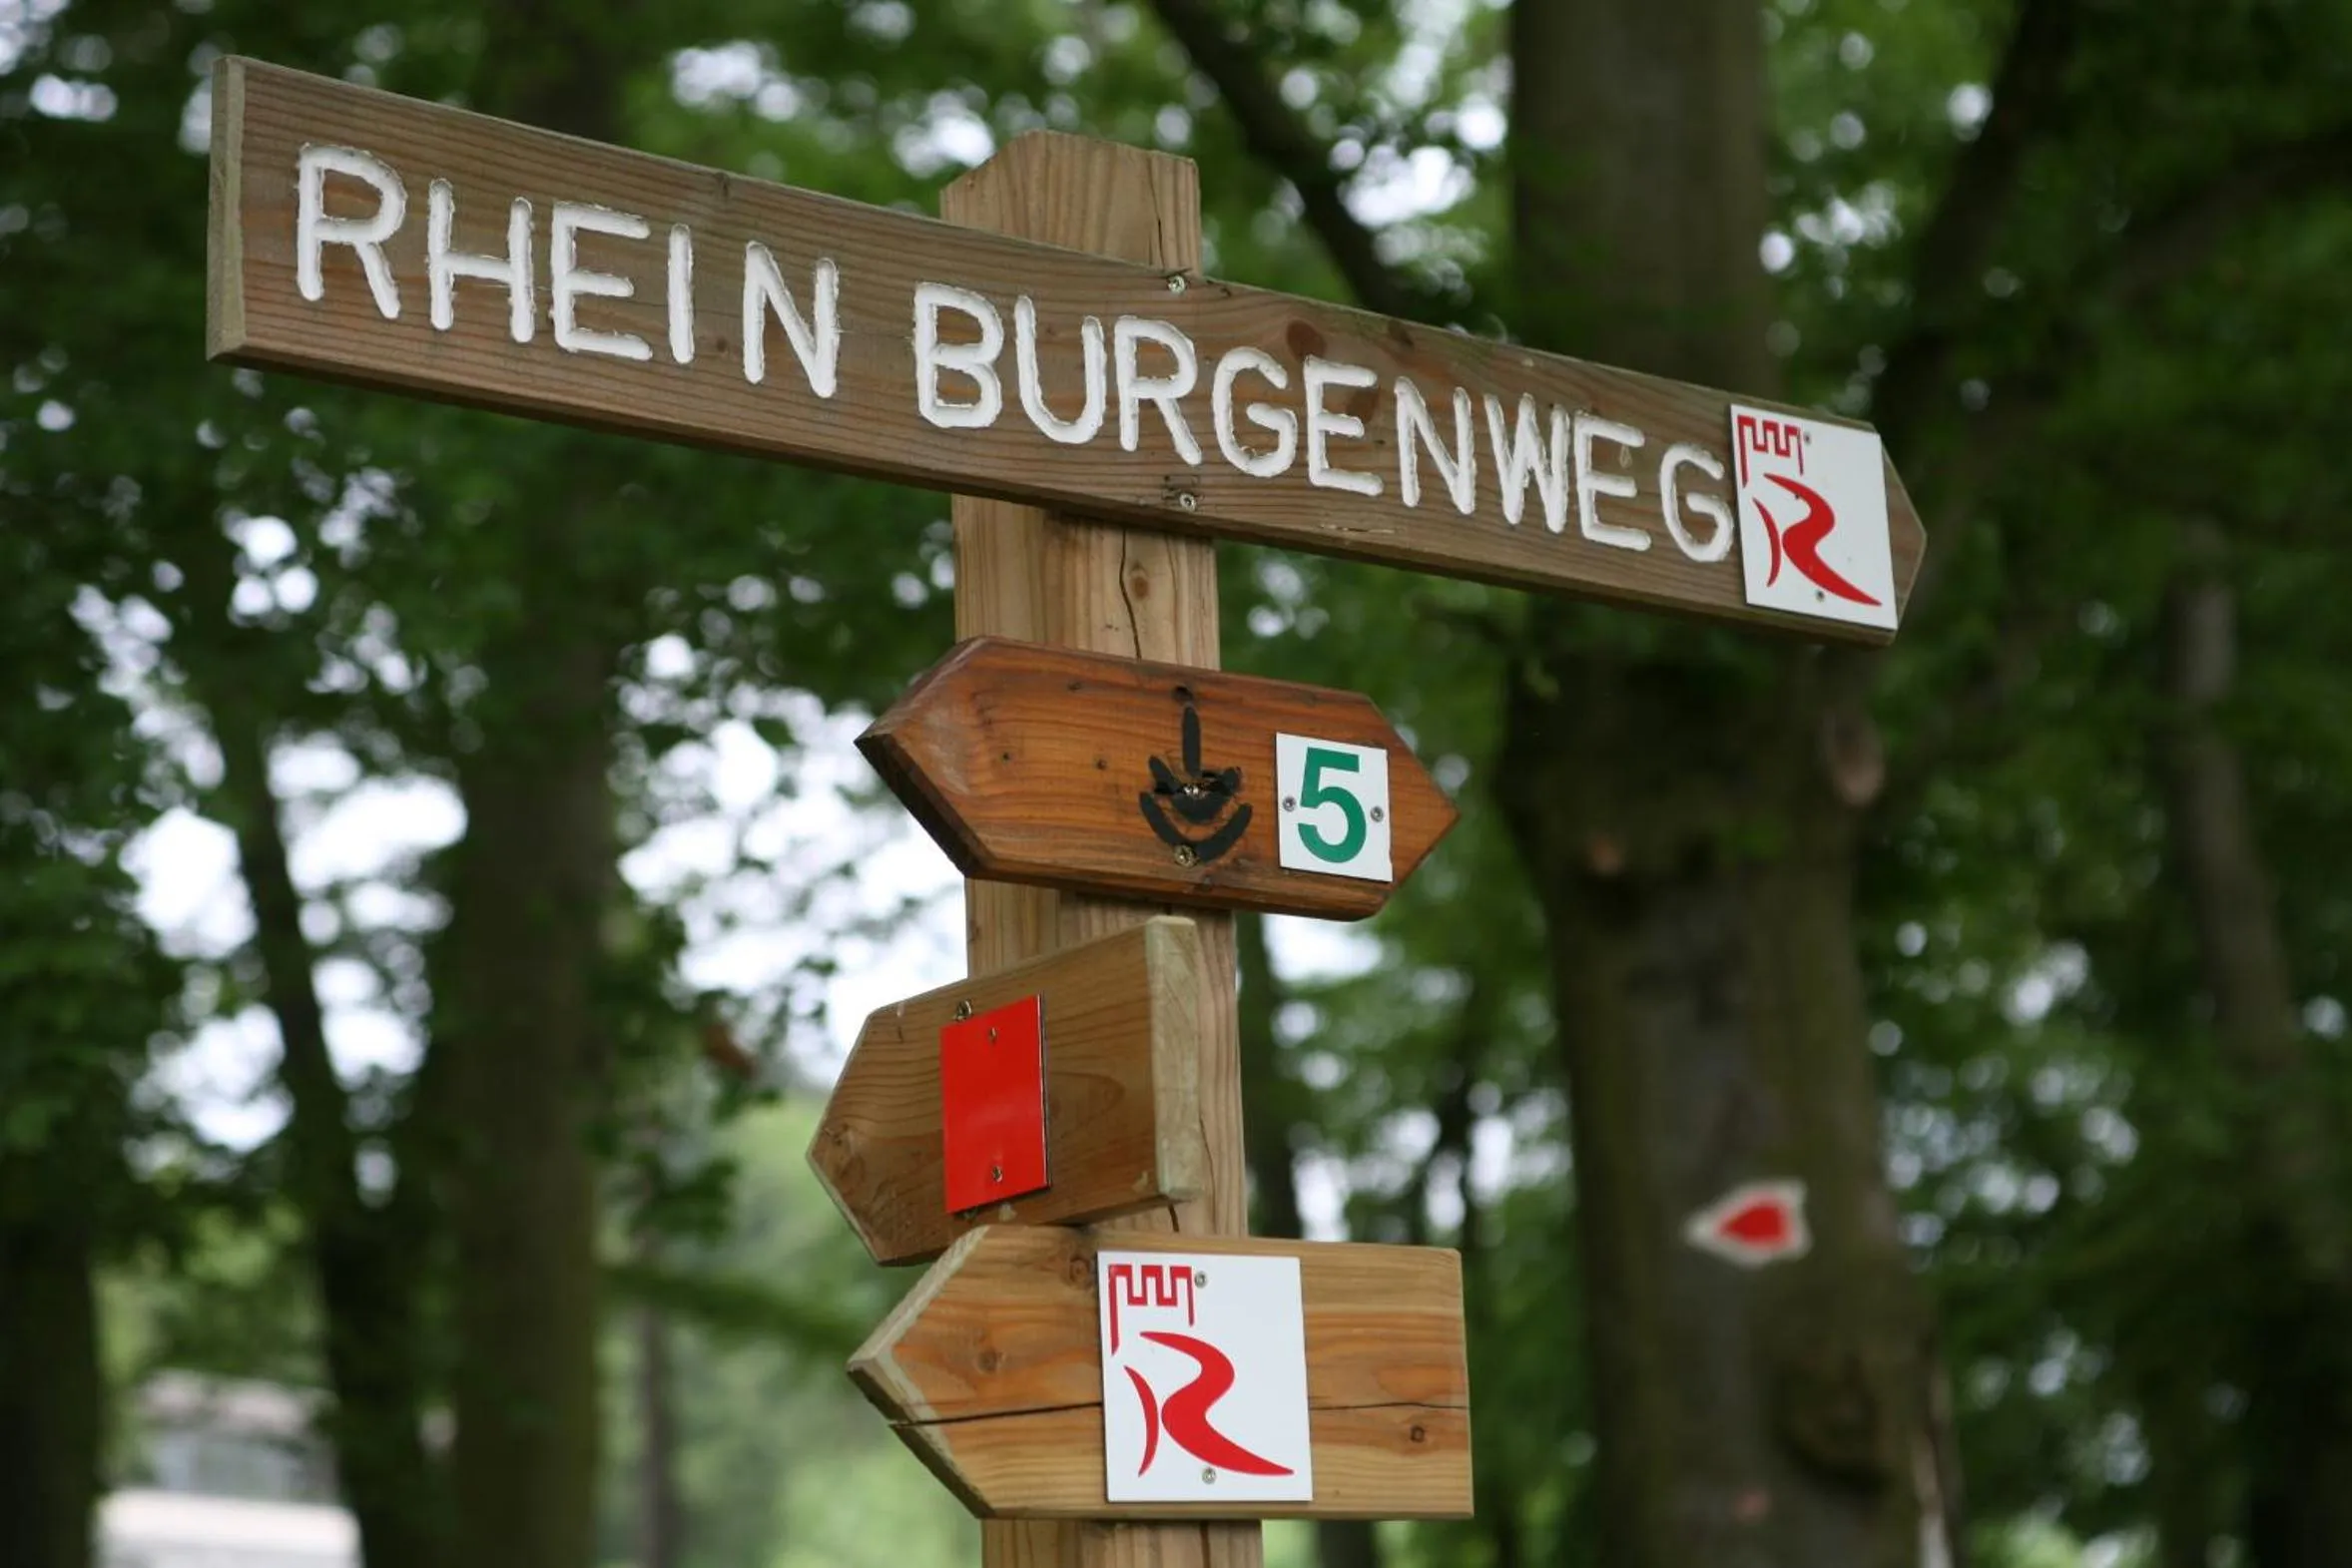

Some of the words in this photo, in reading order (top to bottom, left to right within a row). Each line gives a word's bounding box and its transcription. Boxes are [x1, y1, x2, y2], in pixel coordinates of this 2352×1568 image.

[296, 143, 841, 398] RHEIN
[912, 281, 1735, 563] BURGENWEG
[1297, 747, 1368, 864] 5
